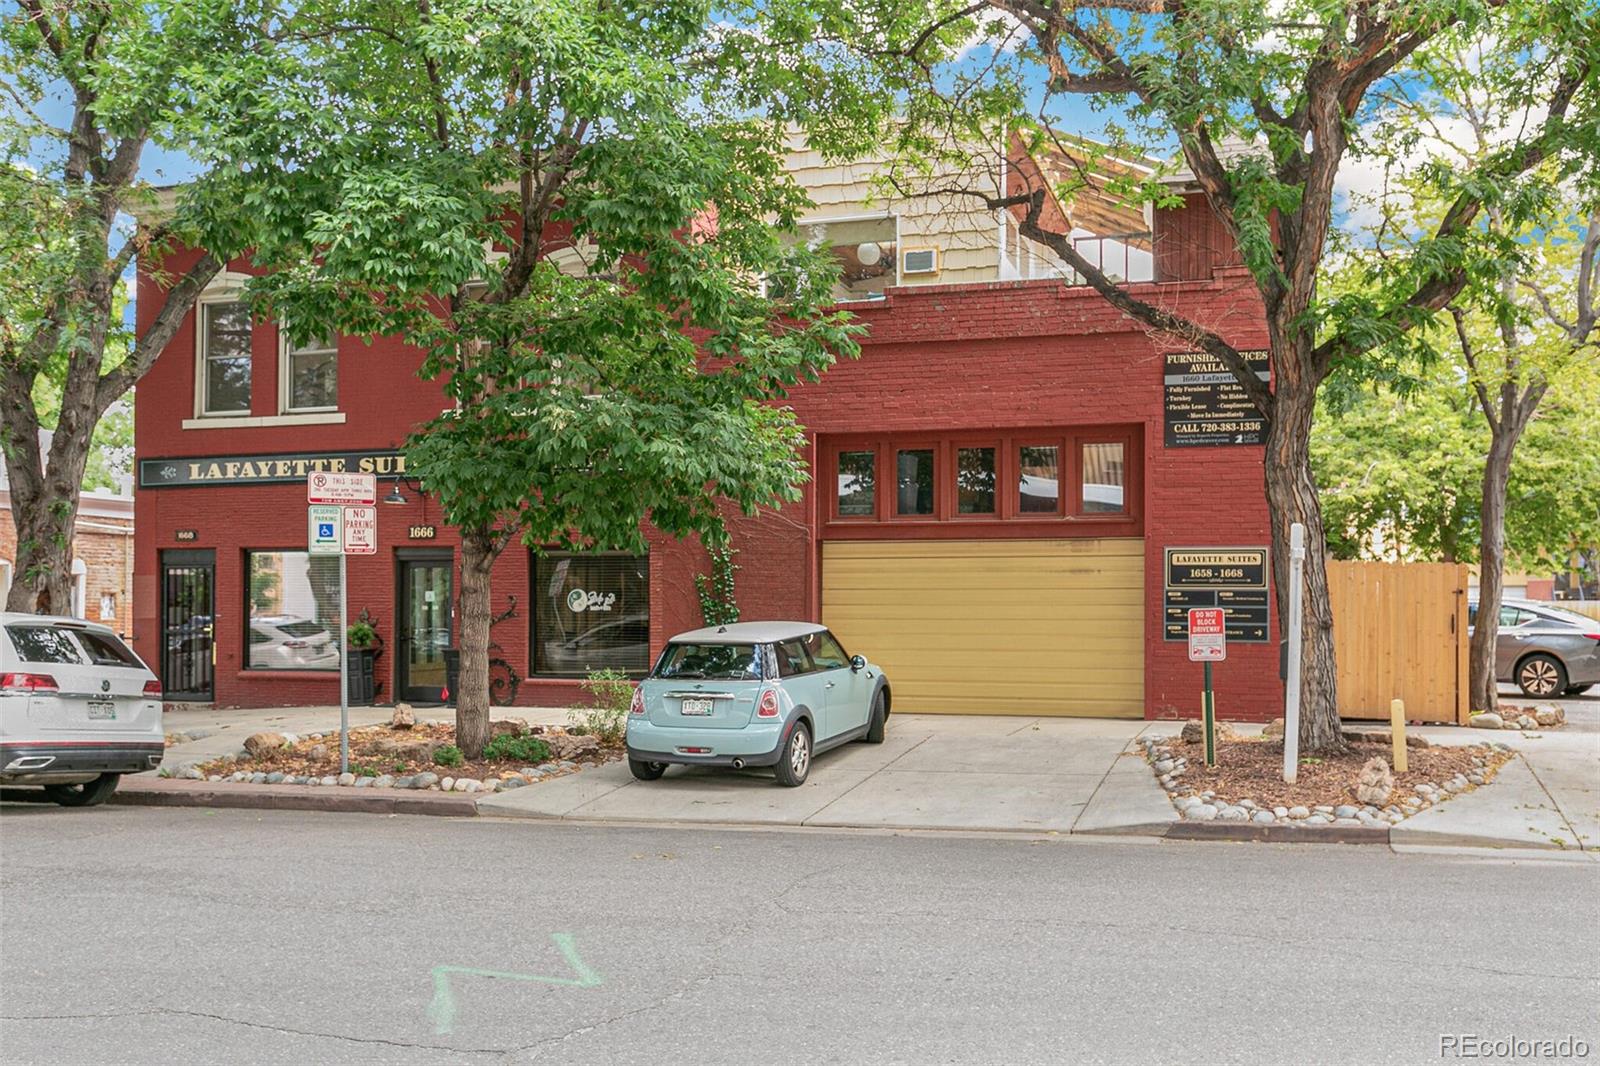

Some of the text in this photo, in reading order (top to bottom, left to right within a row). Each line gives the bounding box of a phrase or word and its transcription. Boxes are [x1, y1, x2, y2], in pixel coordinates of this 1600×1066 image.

[1167, 354, 1221, 364] FURNISHE
[1190, 362, 1229, 373] AVAILA
[1184, 385, 1211, 393] Furnished
[1174, 422, 1261, 433] CALL 720-383-1336
[189, 456, 406, 480] LAFAYETTE SUI
[353, 509, 366, 518] NO
[346, 520, 374, 529] PARKING
[409, 527, 434, 538] 1666
[1190, 569, 1213, 578] 1658
[1220, 568, 1243, 578] 1668
